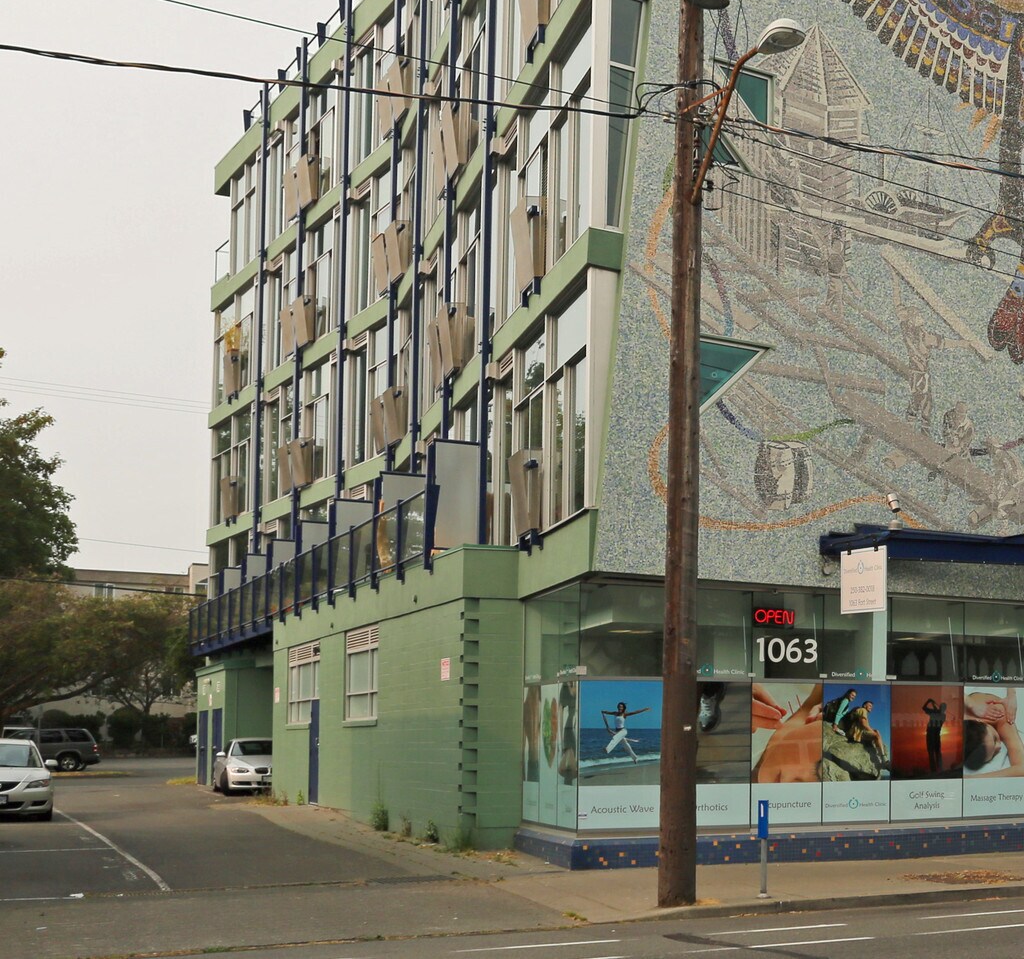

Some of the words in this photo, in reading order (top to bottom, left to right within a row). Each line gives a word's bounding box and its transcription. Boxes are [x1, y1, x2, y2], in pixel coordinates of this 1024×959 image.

[754, 609, 795, 625] OPEN
[756, 637, 818, 664] 1063
[730, 668, 745, 676] Clinic
[831, 671, 856, 679] Diversified
[909, 791, 924, 800] Golf
[925, 790, 945, 800] Swing
[970, 794, 997, 804] Massage
[999, 793, 1023, 803] Therapy
[590, 805, 627, 814] Acoustic
[629, 805, 655, 814] Wave
[695, 804, 728, 812] rthotics
[768, 801, 812, 810] cupuncture
[914, 801, 940, 811] Analysis
